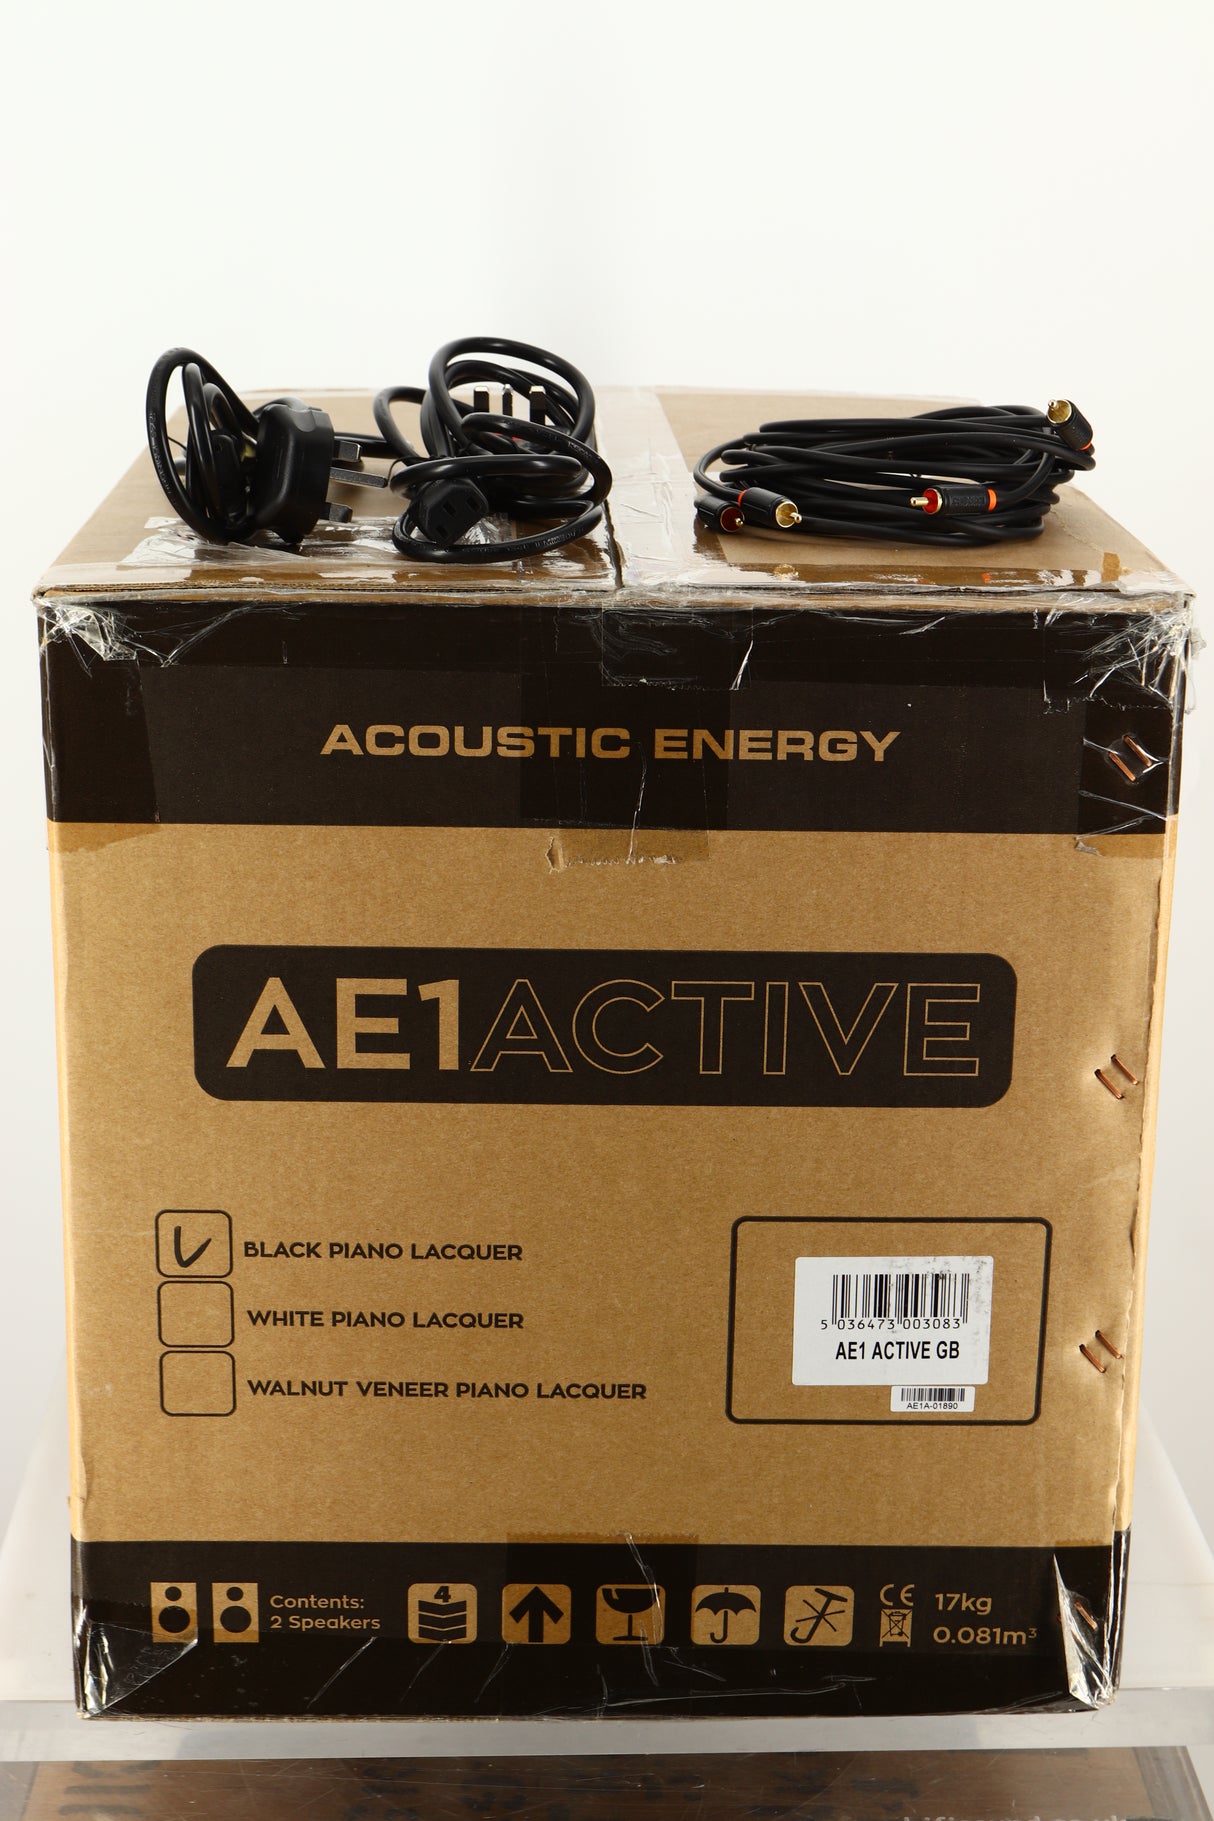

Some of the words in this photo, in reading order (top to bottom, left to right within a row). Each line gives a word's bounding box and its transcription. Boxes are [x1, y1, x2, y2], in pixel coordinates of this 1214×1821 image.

[319, 724, 630, 759] ACOUSTIC
[654, 728, 901, 762] ENERGY
[243, 1241, 323, 1259] BLACK
[329, 1242, 404, 1260] PIANO
[411, 1243, 523, 1261] LACQUER
[246, 1309, 325, 1327] WHITE
[331, 1310, 406, 1328] PIANO
[412, 1311, 524, 1330] LACQUER
[820, 1319, 828, 1330] 5
[836, 1318, 895, 1331] 036473
[902, 1318, 961, 1330] 003083
[835, 1341, 865, 1360] AE1
[871, 1340, 931, 1360] ACTIVE
[936, 1340, 960, 1360] GB
[246, 1379, 349, 1397] WALNUT
[355, 1380, 449, 1398] VENEER
[455, 1382, 530, 1399] PIANO
[536, 1382, 647, 1400] LACQUER
[906, 1401, 959, 1410] AE1A-01890
[269, 1594, 364, 1609] Contents:
[935, 1592, 992, 1616] 17kg
[270, 1615, 282, 1629] 2
[288, 1615, 381, 1632] Speakers
